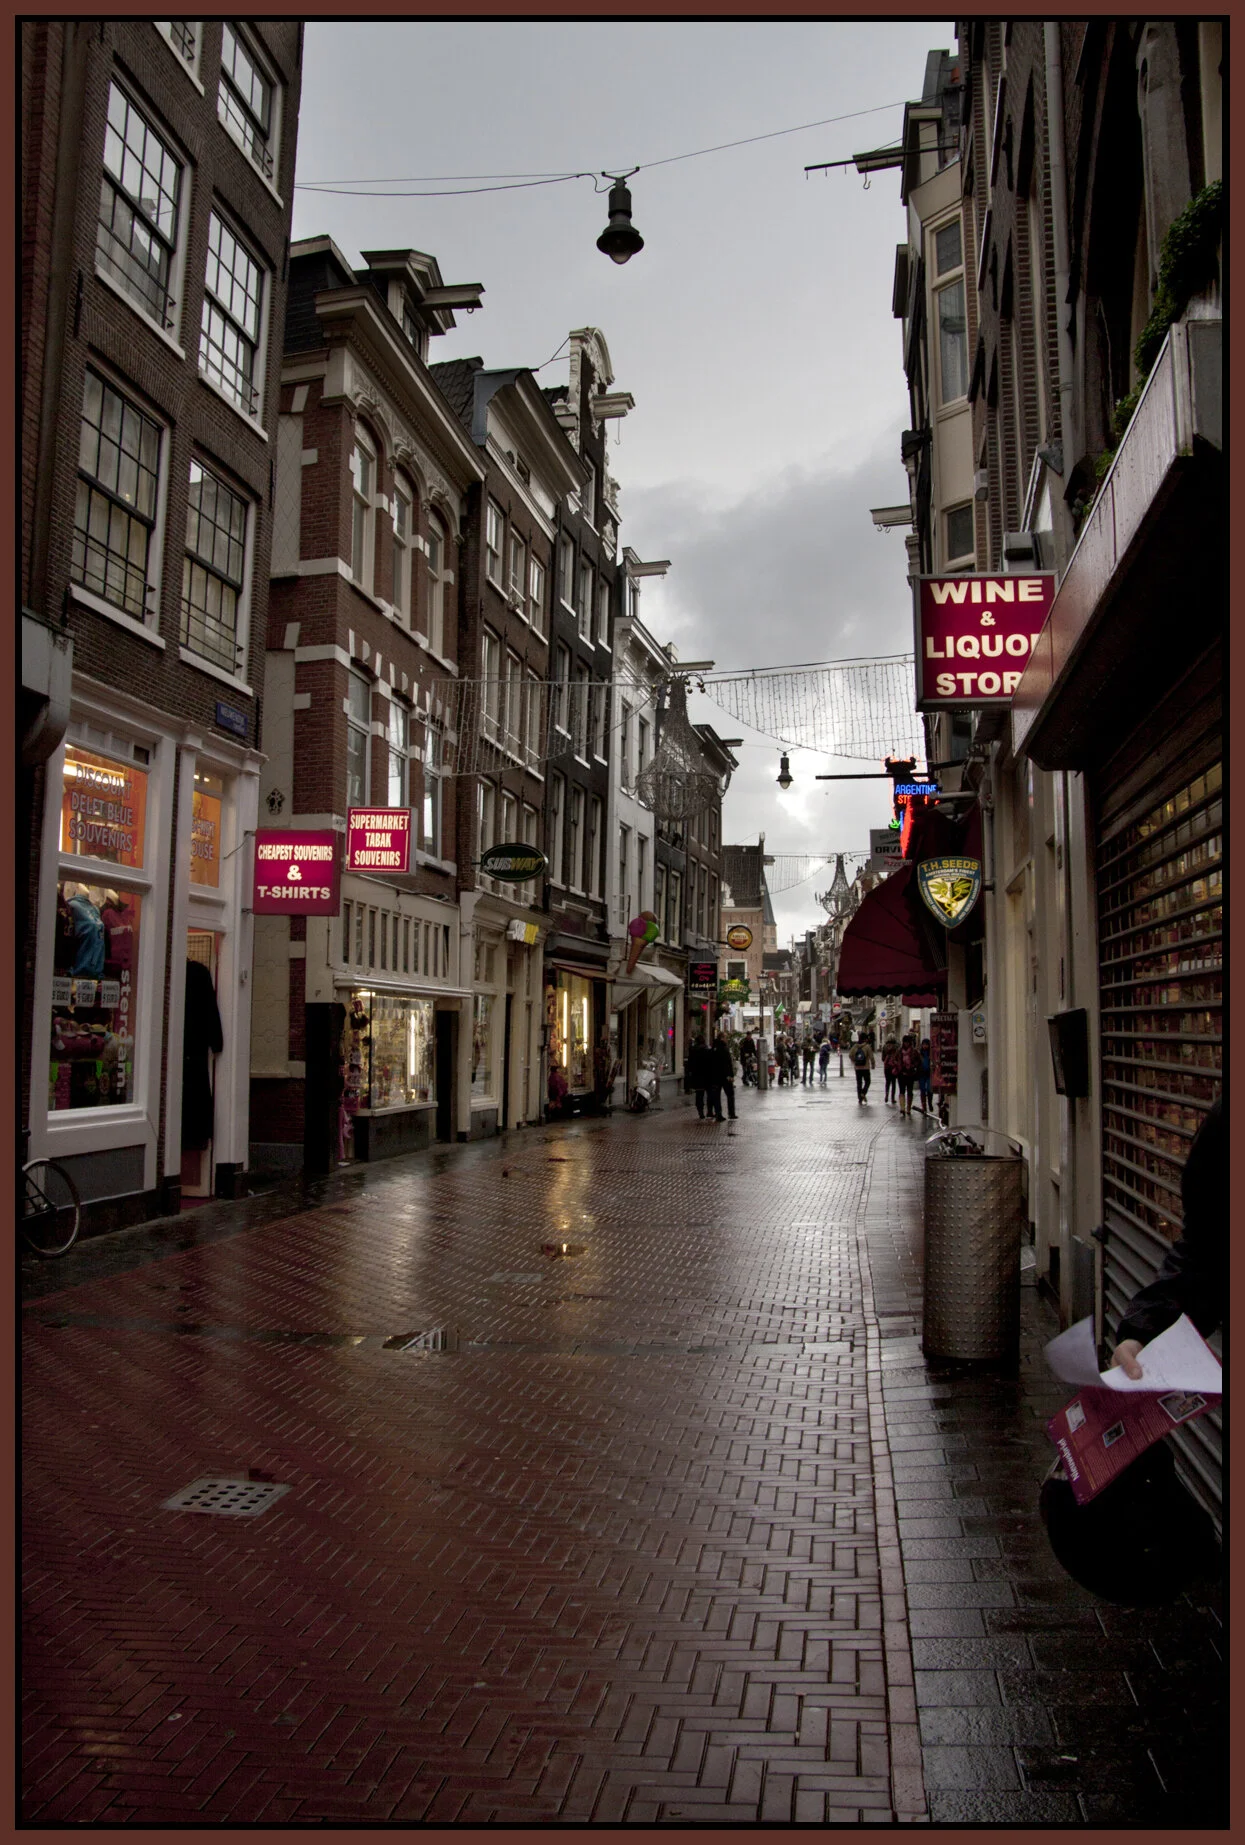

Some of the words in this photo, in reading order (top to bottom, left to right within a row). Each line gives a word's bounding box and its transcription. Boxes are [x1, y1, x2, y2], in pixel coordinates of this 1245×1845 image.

[930, 579, 1044, 604] WINE
[980, 611, 996, 626] &
[76, 764, 132, 799] DISCOUNT
[107, 802, 133, 826] BLUE
[350, 814, 409, 830] SUPERMARKET
[69, 818, 133, 852] SOUVENIRS
[365, 832, 392, 847] TABAK
[258, 844, 293, 860] CHEAPEST
[294, 845, 333, 861] SOUVENIRS
[354, 850, 401, 866] SOUVENIRS
[484, 857, 544, 871] SUBWAY
[287, 865, 302, 880] &
[257, 886, 331, 899] T-SHIRTS
